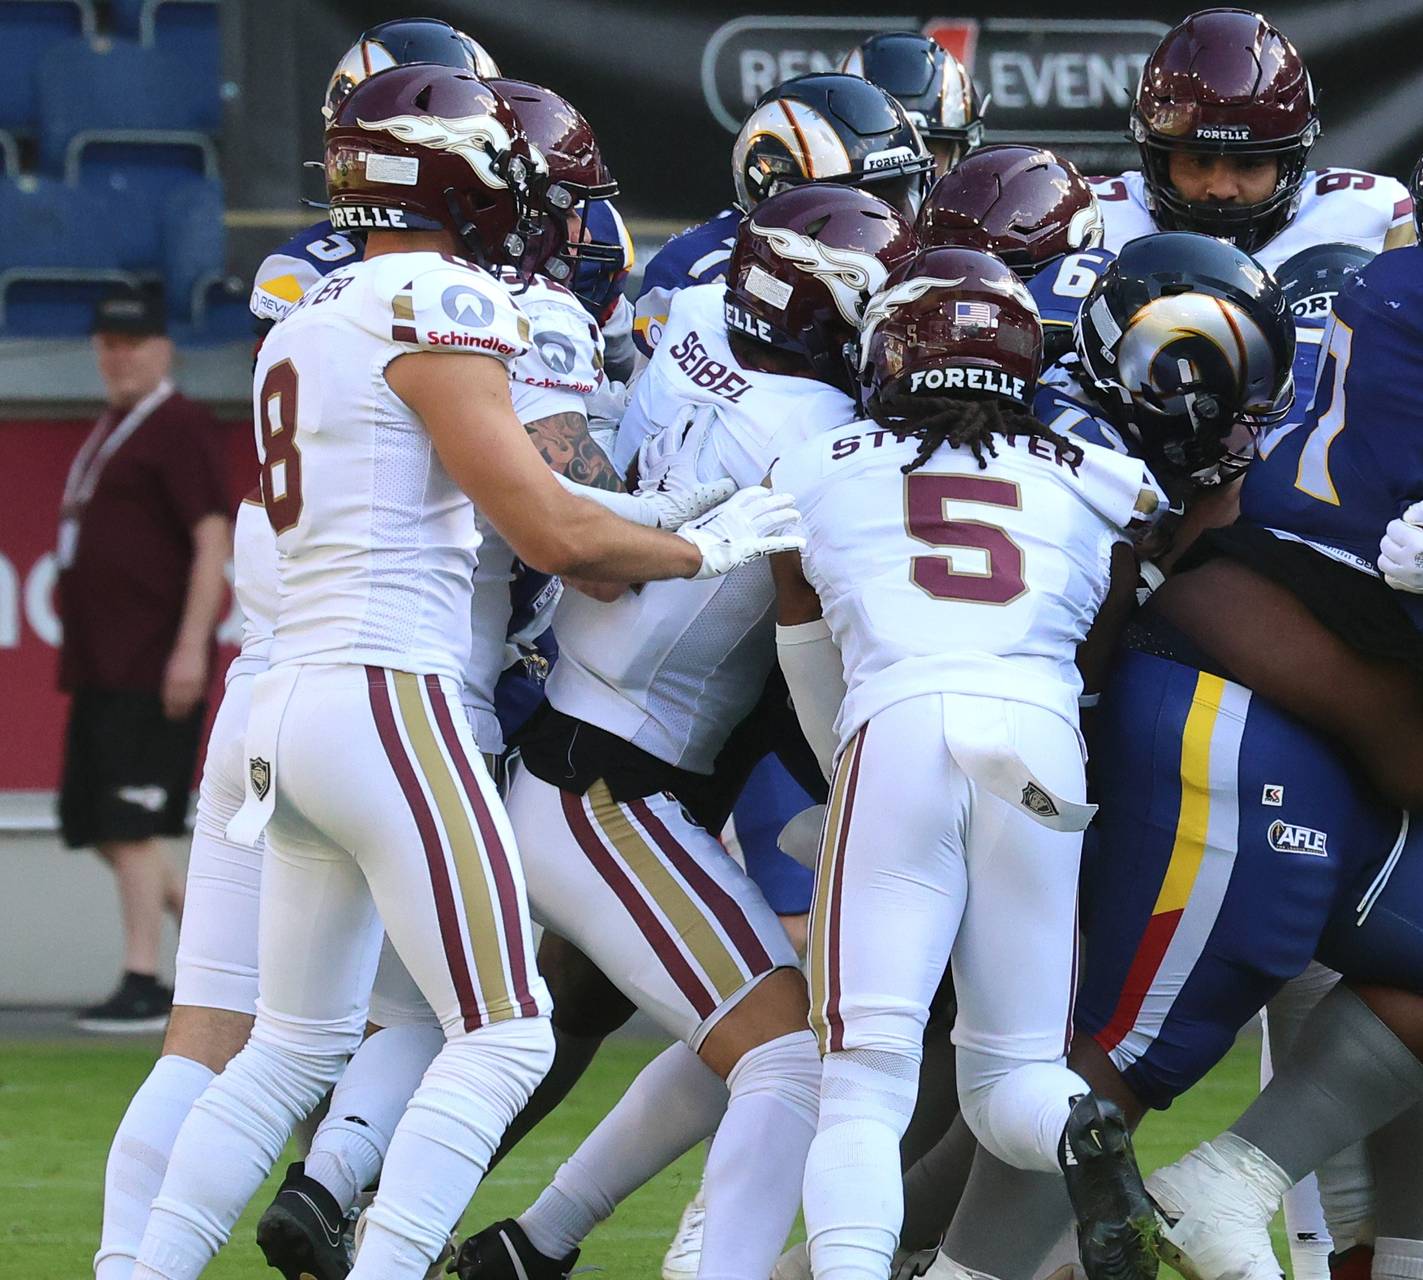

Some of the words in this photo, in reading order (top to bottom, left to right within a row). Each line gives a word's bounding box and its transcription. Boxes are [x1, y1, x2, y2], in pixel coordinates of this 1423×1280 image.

[1196, 128, 1250, 142] FORELLE
[868, 153, 913, 170] FORELLE
[330, 206, 408, 229] ORELLE
[1052, 254, 1106, 298] 6
[427, 330, 516, 357] Schindler
[669, 330, 754, 404] SEIBEL
[910, 367, 1026, 401] FORELLE
[259, 357, 305, 539] 8
[902, 471, 1031, 607] 5
[1277, 826, 1325, 851] AFLE
